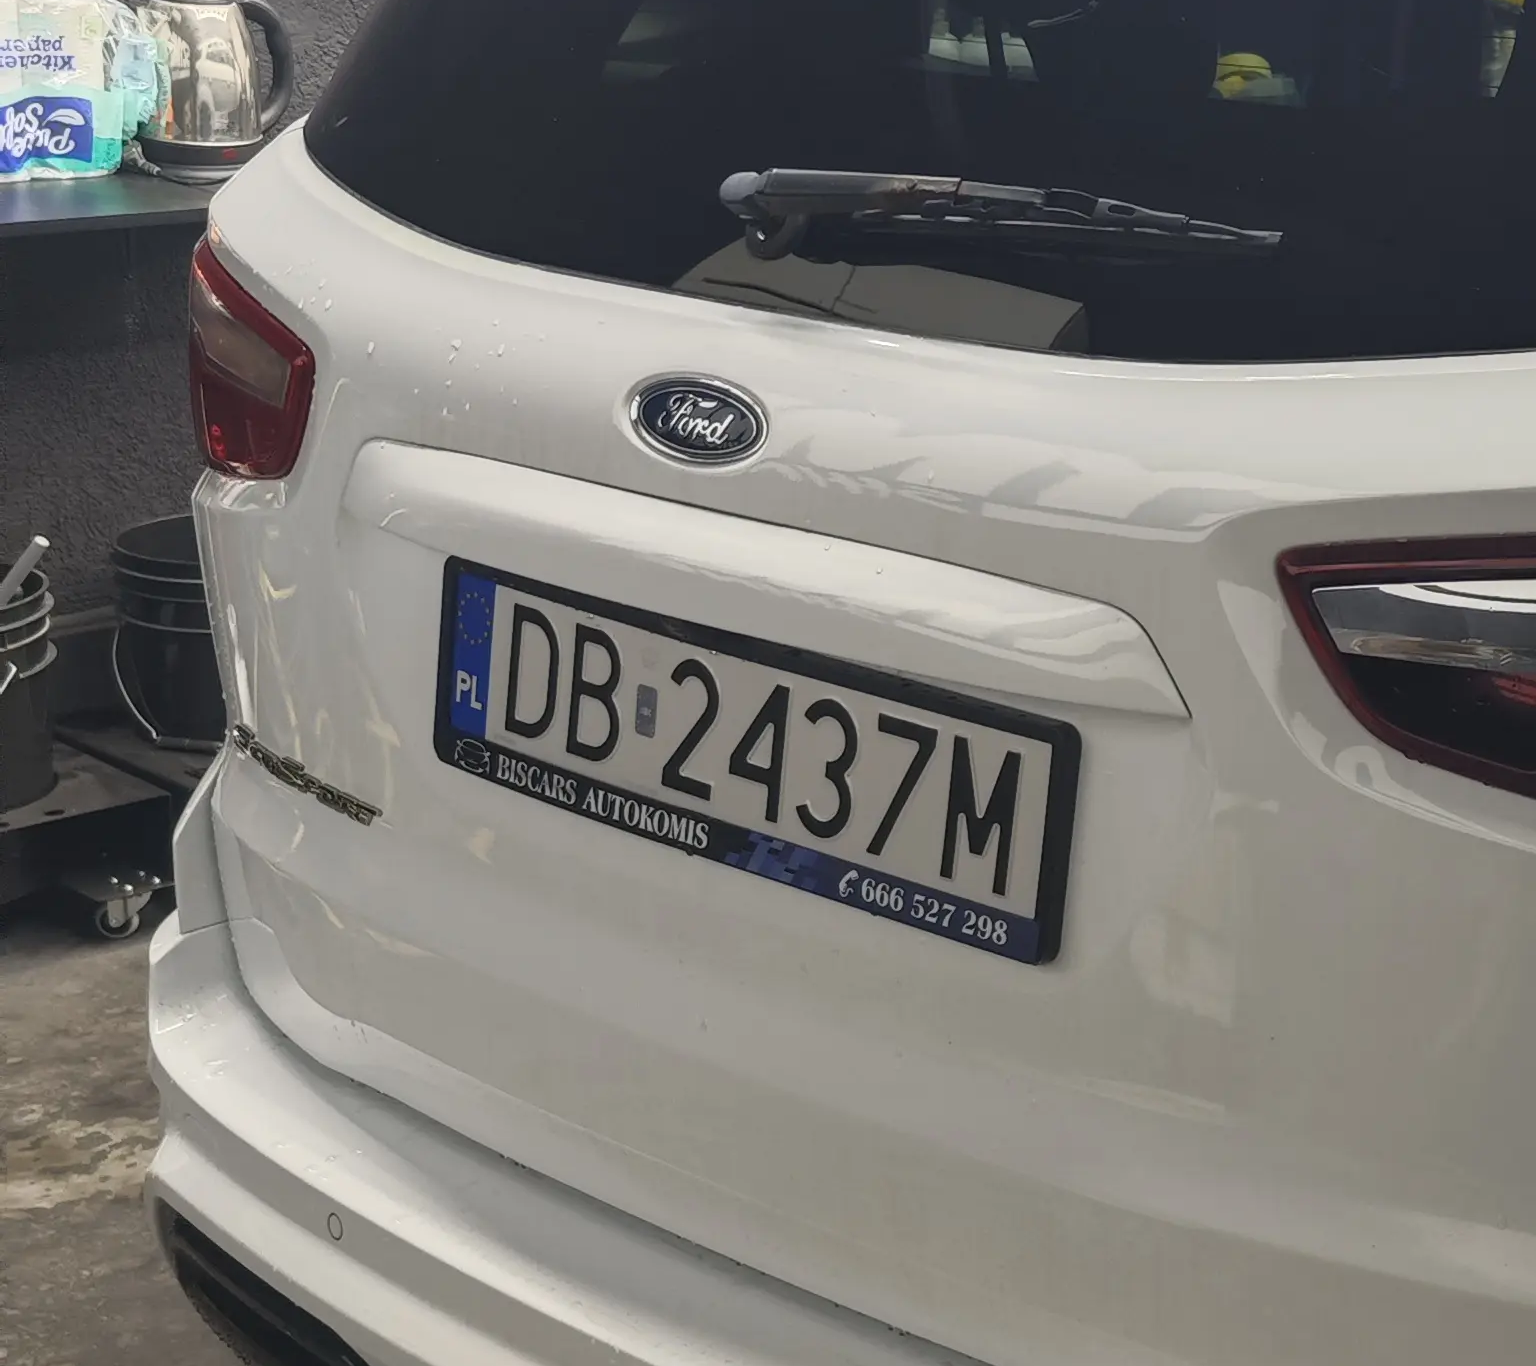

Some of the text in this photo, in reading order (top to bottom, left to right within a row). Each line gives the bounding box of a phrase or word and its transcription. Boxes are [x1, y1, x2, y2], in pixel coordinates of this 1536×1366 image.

[658, 393, 735, 445] Ford
[455, 669, 482, 712] PL
[504, 602, 1022, 897] DB 2437M
[496, 754, 709, 849] BISCARS AUTOKOMIS
[861, 878, 1008, 946] 666 527 298
